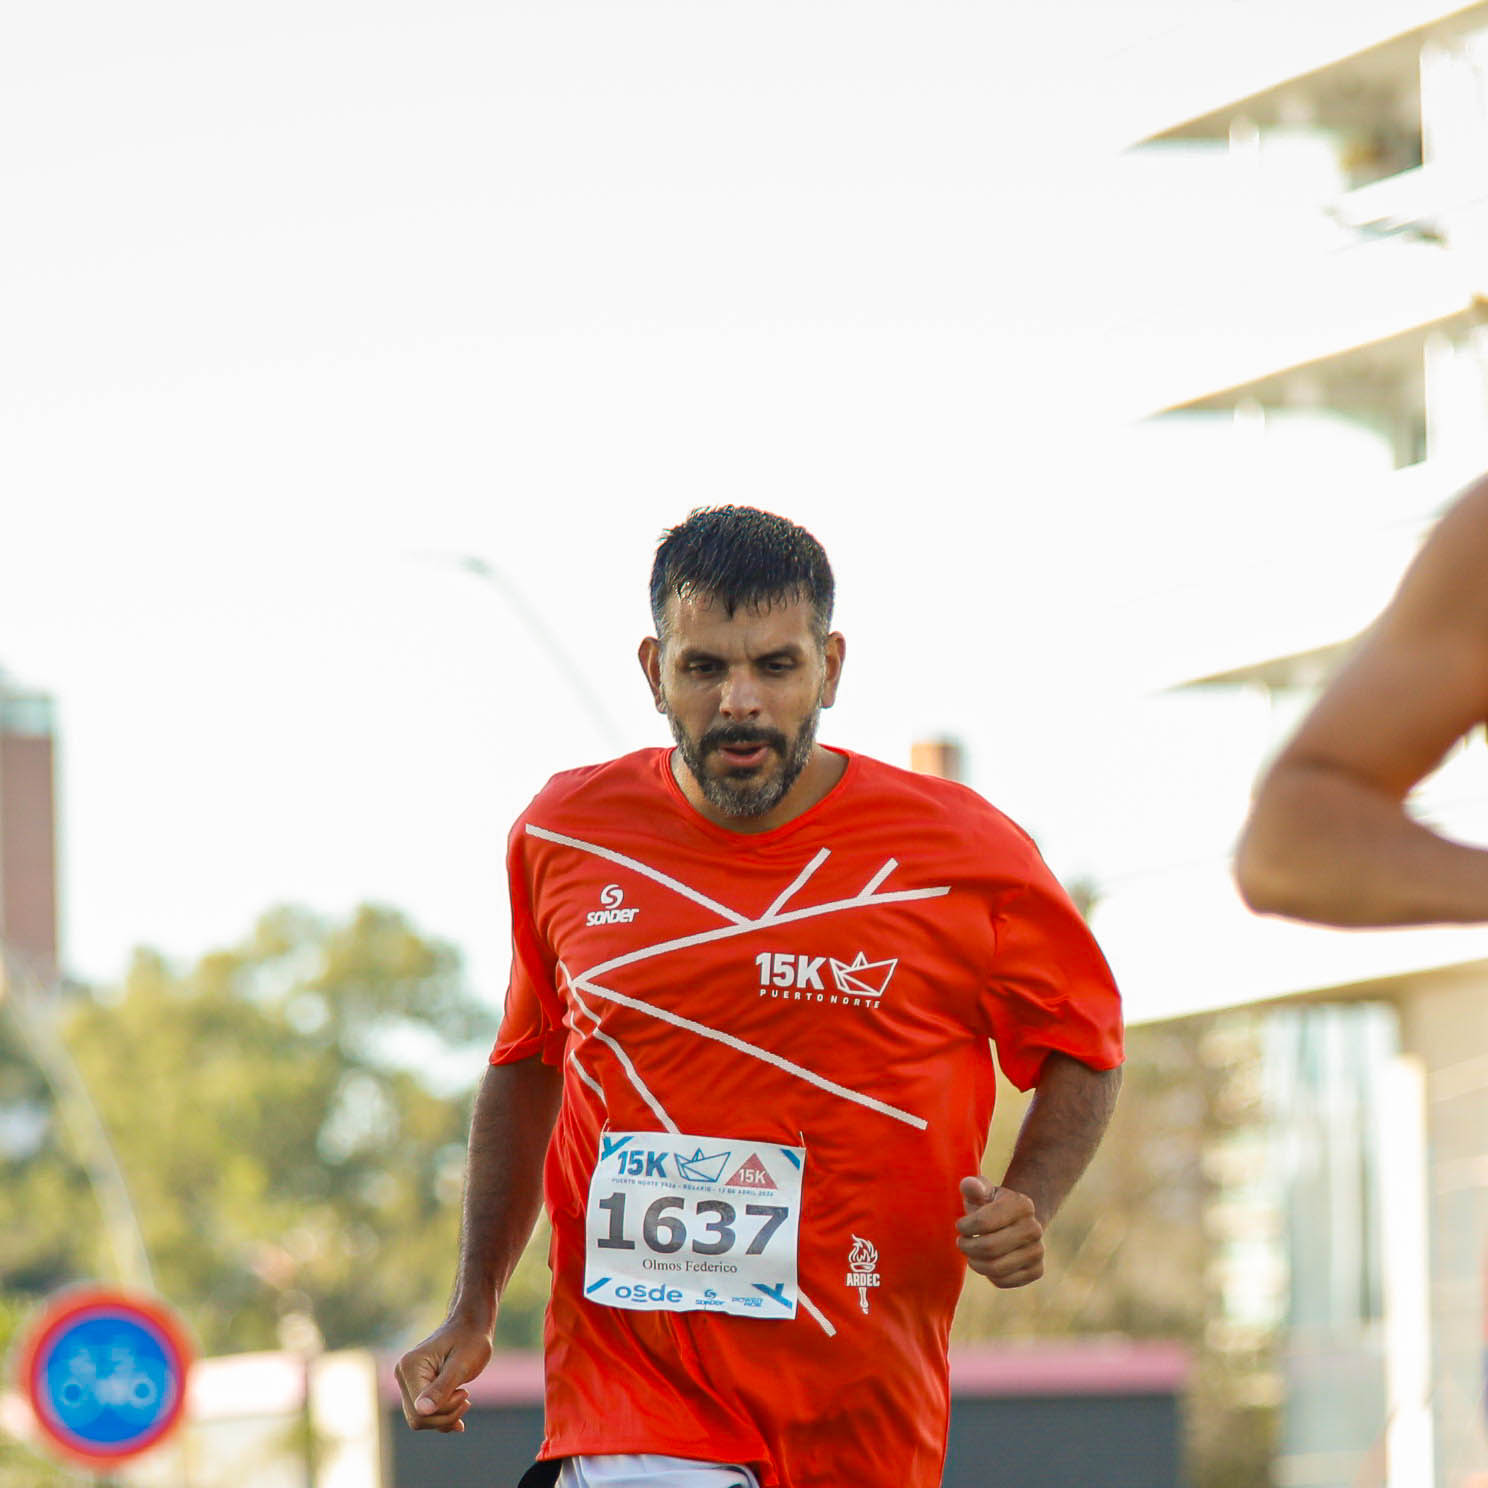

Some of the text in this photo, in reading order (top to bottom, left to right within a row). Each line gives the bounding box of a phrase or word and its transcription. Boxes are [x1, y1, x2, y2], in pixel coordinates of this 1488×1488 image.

[755, 952, 826, 990] 15K
[760, 989, 880, 1008] PUERTO NORTE
[617, 1150, 766, 1184] 15K 15K
[597, 1192, 789, 1255] 1637
[643, 1259, 738, 1273] Olmos Federico
[846, 1272, 880, 1287] ARDEC
[615, 1283, 683, 1302] osde
